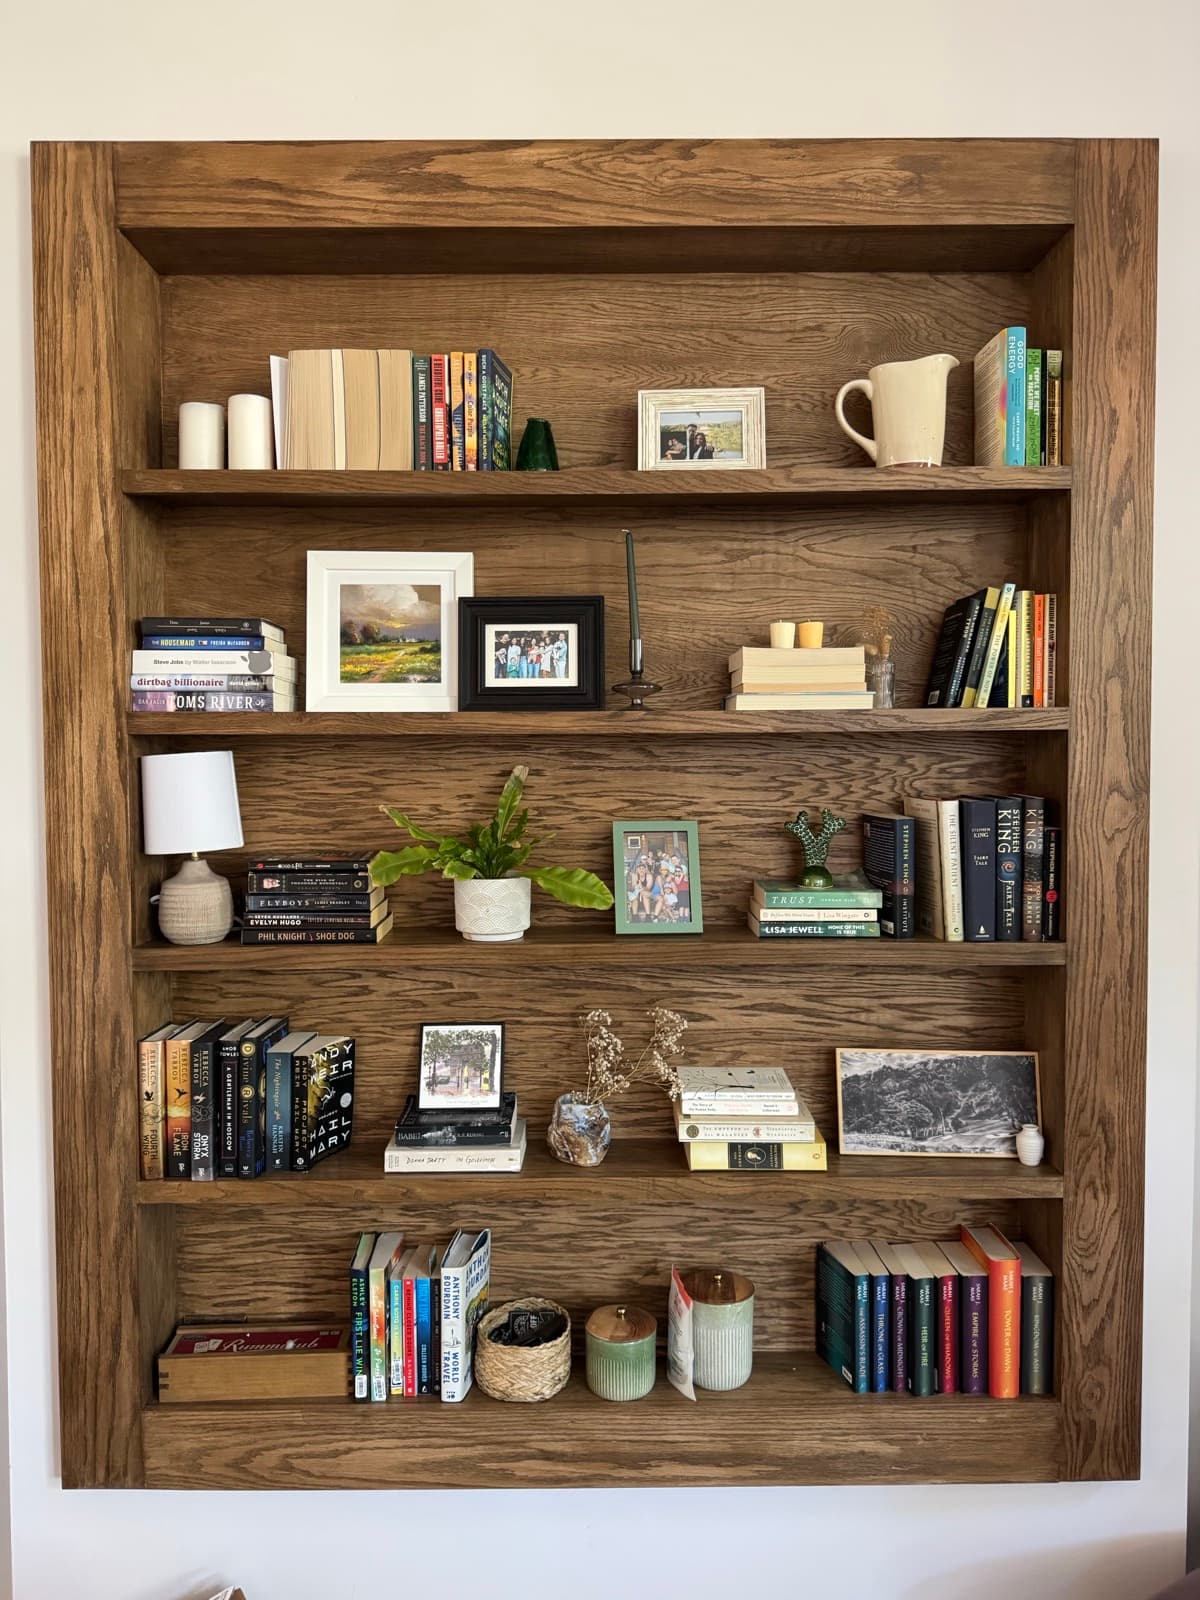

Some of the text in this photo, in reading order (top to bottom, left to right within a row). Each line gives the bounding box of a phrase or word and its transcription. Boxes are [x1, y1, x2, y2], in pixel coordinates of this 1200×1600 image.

[418, 372, 426, 390] JAMES
[418, 392, 426, 422] PATTERSON
[988, 647, 997, 669] POWER
[137, 678, 224, 687] dirtbag billionaire
[985, 669, 992, 679] OF
[168, 696, 253, 708] TOMS RIVER
[998, 809, 1011, 854] KING
[1026, 809, 1036, 850] KING
[1000, 880, 1015, 927] FAIRY TALE
[310, 1044, 353, 1068] ANDY
[242, 1044, 252, 1124] Divine Rivals
[273, 1058, 282, 1107] The Nightingale
[310, 1060, 353, 1085] WEIR
[310, 1116, 351, 1142] HAIL
[173, 1128, 181, 1156] FLAME
[310, 1130, 350, 1160] MARY
[530, 1315, 538, 1328] OFF
[222, 1337, 320, 1352] Rummikub
